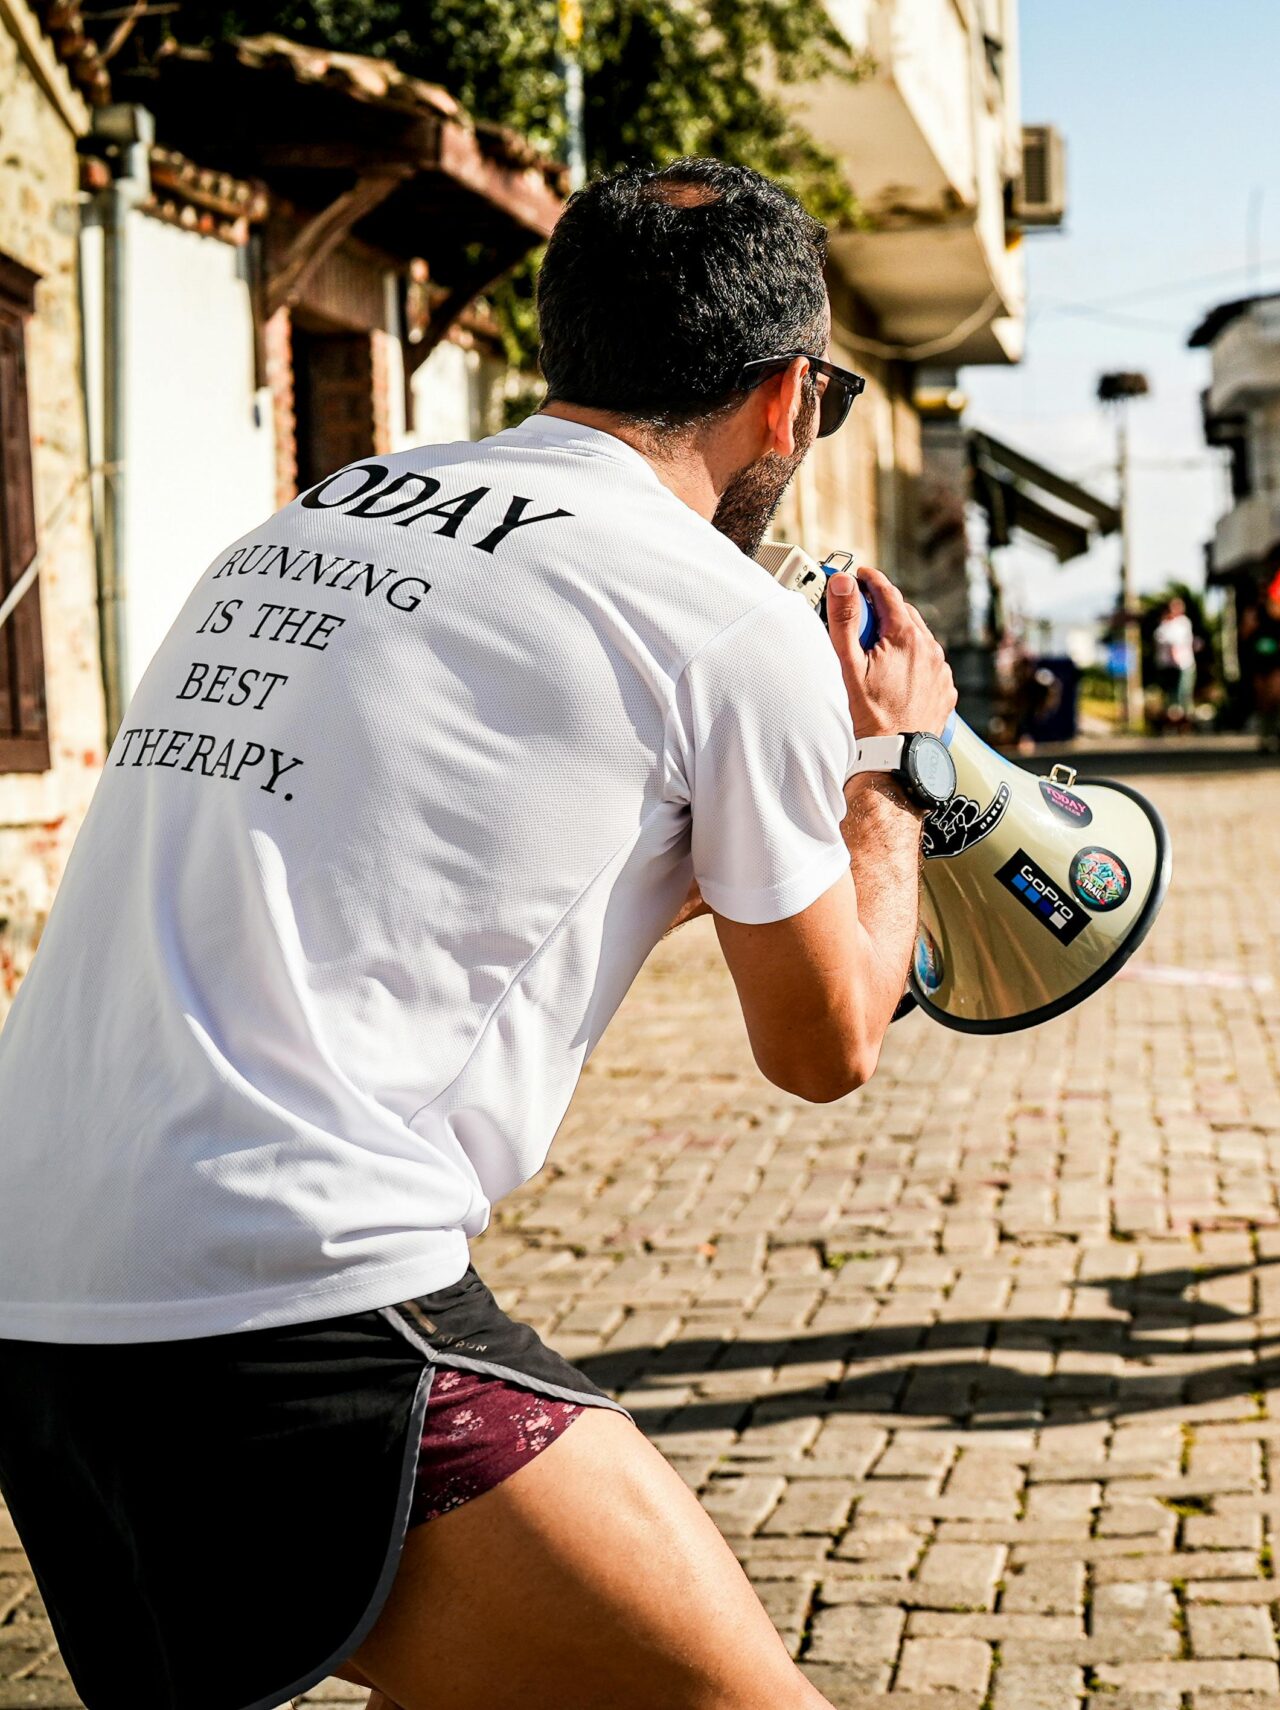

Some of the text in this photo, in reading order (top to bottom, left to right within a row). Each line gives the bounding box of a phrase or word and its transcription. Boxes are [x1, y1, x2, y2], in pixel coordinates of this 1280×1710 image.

[301, 464, 576, 555] ODAY
[212, 544, 432, 612] RUNNING
[196, 599, 346, 651] IS THE
[176, 662, 288, 710] BEST
[115, 728, 304, 801] THERAPY.
[1046, 786, 1087, 813] TODAY
[1020, 865, 1074, 920] GoPro
[1082, 879, 1103, 900] TRAIL
